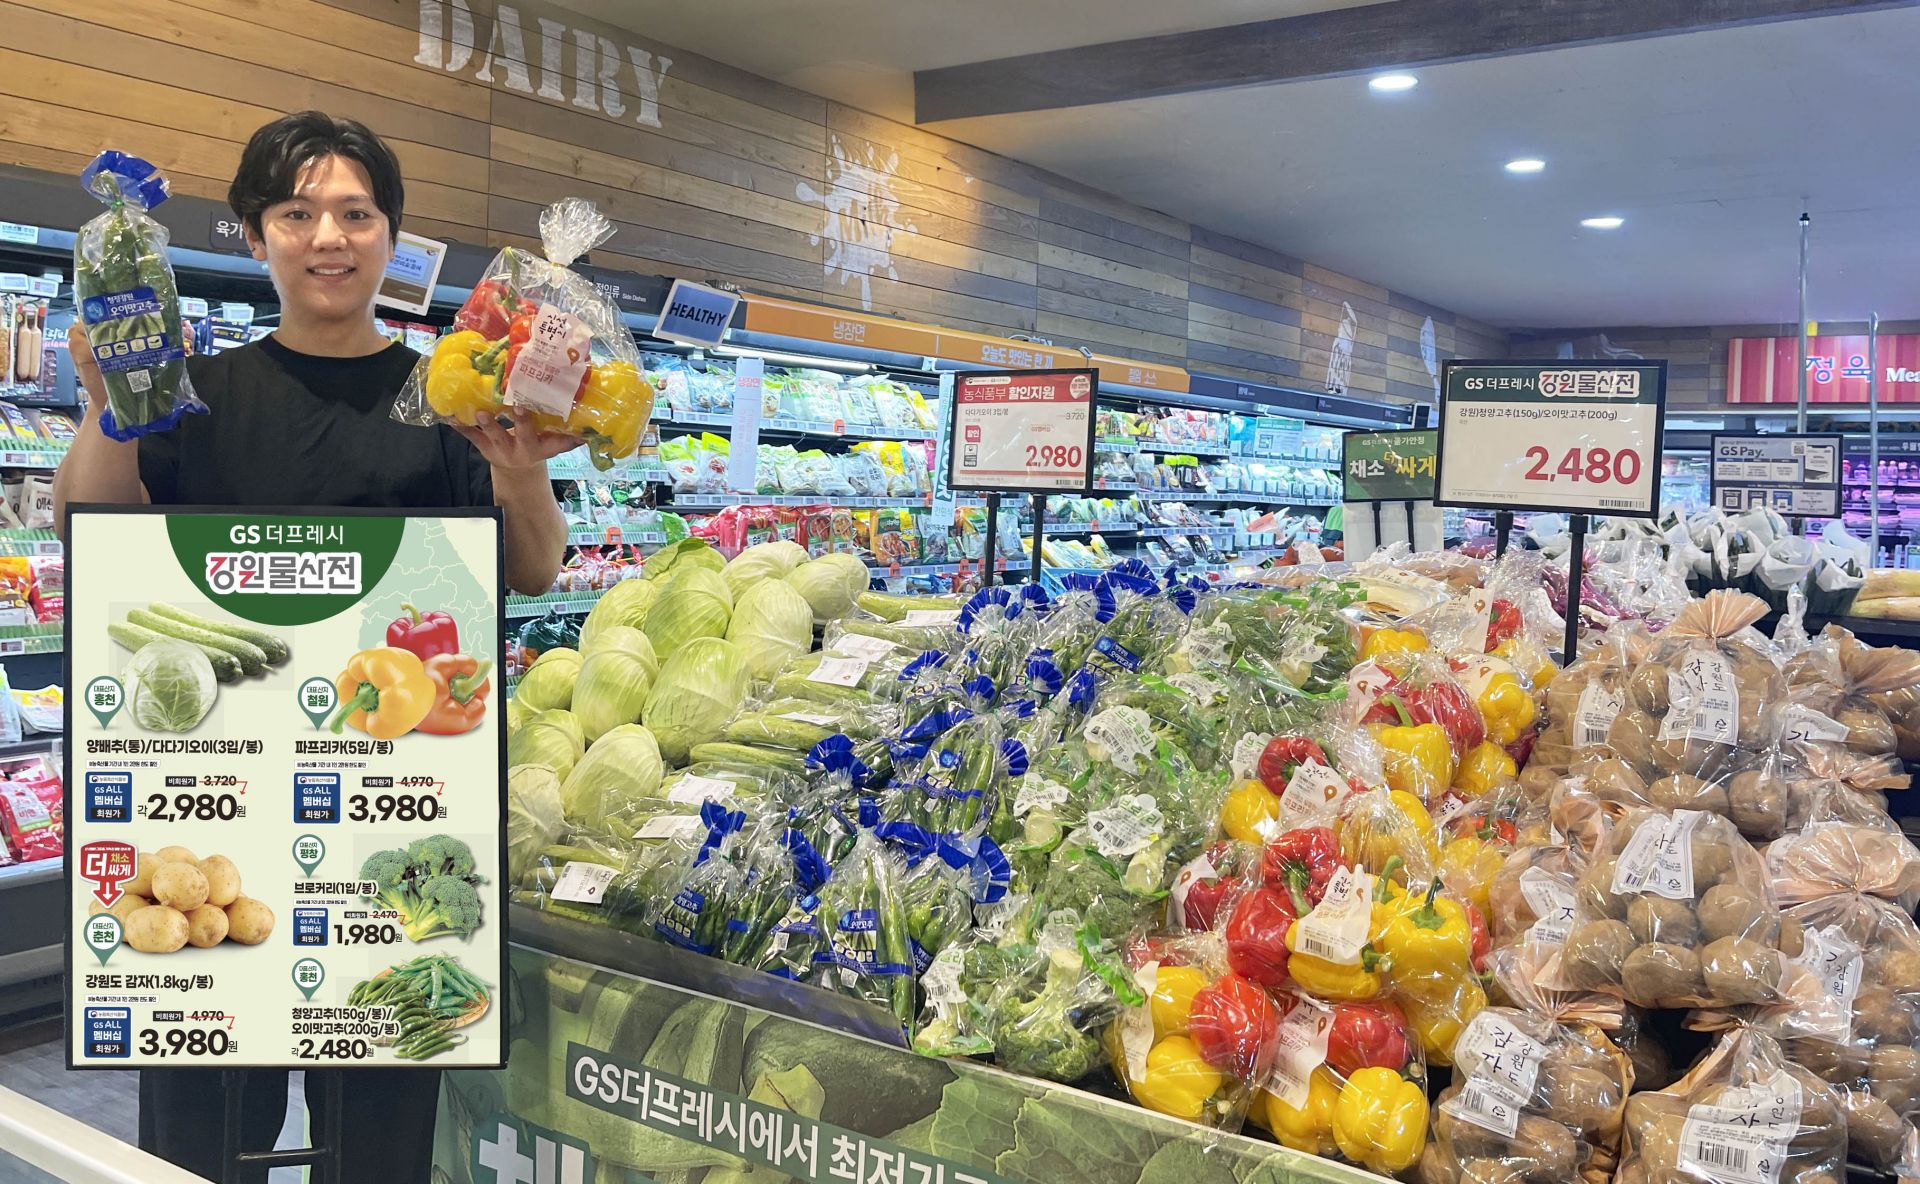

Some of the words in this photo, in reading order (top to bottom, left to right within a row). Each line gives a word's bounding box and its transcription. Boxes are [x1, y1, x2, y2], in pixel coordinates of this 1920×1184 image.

[413, 0, 674, 128] DAIRY
[110, 300, 154, 317] 오이맛고추
[669, 302, 726, 327] HEALTHY
[833, 320, 866, 343] 냉장면
[519, 362, 554, 384] 파프리카
[1464, 378, 1484, 390] GS
[1487, 377, 1535, 391] 더프레시
[1541, 373, 1635, 395] 강원물산전
[964, 388, 1006, 401] 농식품부
[1008, 386, 1055, 400] 할인지원
[965, 408, 992, 416] 다다기오이
[1026, 445, 1082, 468] 2,980
[1720, 446, 1738, 456] GS
[1349, 459, 1385, 478] 채소
[1525, 446, 1641, 485] 2,480
[229, 524, 261, 545] GS
[266, 524, 344, 545] 더프레시
[209, 554, 357, 591] 강원물산전
[93, 692, 116, 706] 홍천
[306, 693, 329, 708] 철원
[86, 739, 264, 755] 양배추(통)/다다기오이(3입/봉)
[295, 740, 394, 755] 파프리카(5입/봉)
[168, 777, 195, 786] 비회원가
[203, 776, 237, 786] 3,720
[365, 778, 391, 786] 비회원가
[400, 776, 434, 787] 4,970
[105, 785, 123, 793] ALL
[314, 787, 331, 795] ALL
[94, 795, 123, 806] 멤버십
[303, 796, 332, 807] 멤버십
[96, 809, 121, 818] 회원가
[304, 810, 329, 819] 회원가
[110, 852, 130, 863] 채소
[299, 849, 318, 859] 평창
[86, 853, 107, 877] 더
[107, 864, 131, 877] 싸게
[294, 882, 377, 895] 브로커리(1입/봉)
[372, 910, 398, 919] 2,470
[93, 931, 115, 943] 춘천
[85, 974, 122, 989] 강원도
[125, 974, 214, 992] 감자(1.8kg/봉)
[299, 972, 317, 983] 홍천
[156, 1012, 182, 1020] 비회원가
[191, 1010, 224, 1021] 4,970
[291, 1007, 393, 1022] 청양고추(150g/봉)/
[104, 1020, 122, 1028] ALL
[291, 1023, 400, 1037] 오이맛고추(200g/봉)
[93, 1030, 122, 1041] 멤버십
[95, 1044, 120, 1053] 회원가
[1482, 1026, 1514, 1073] 감자
[1508, 1042, 1535, 1087] 강원도
[574, 1056, 818, 1178] GS더프레시에서
